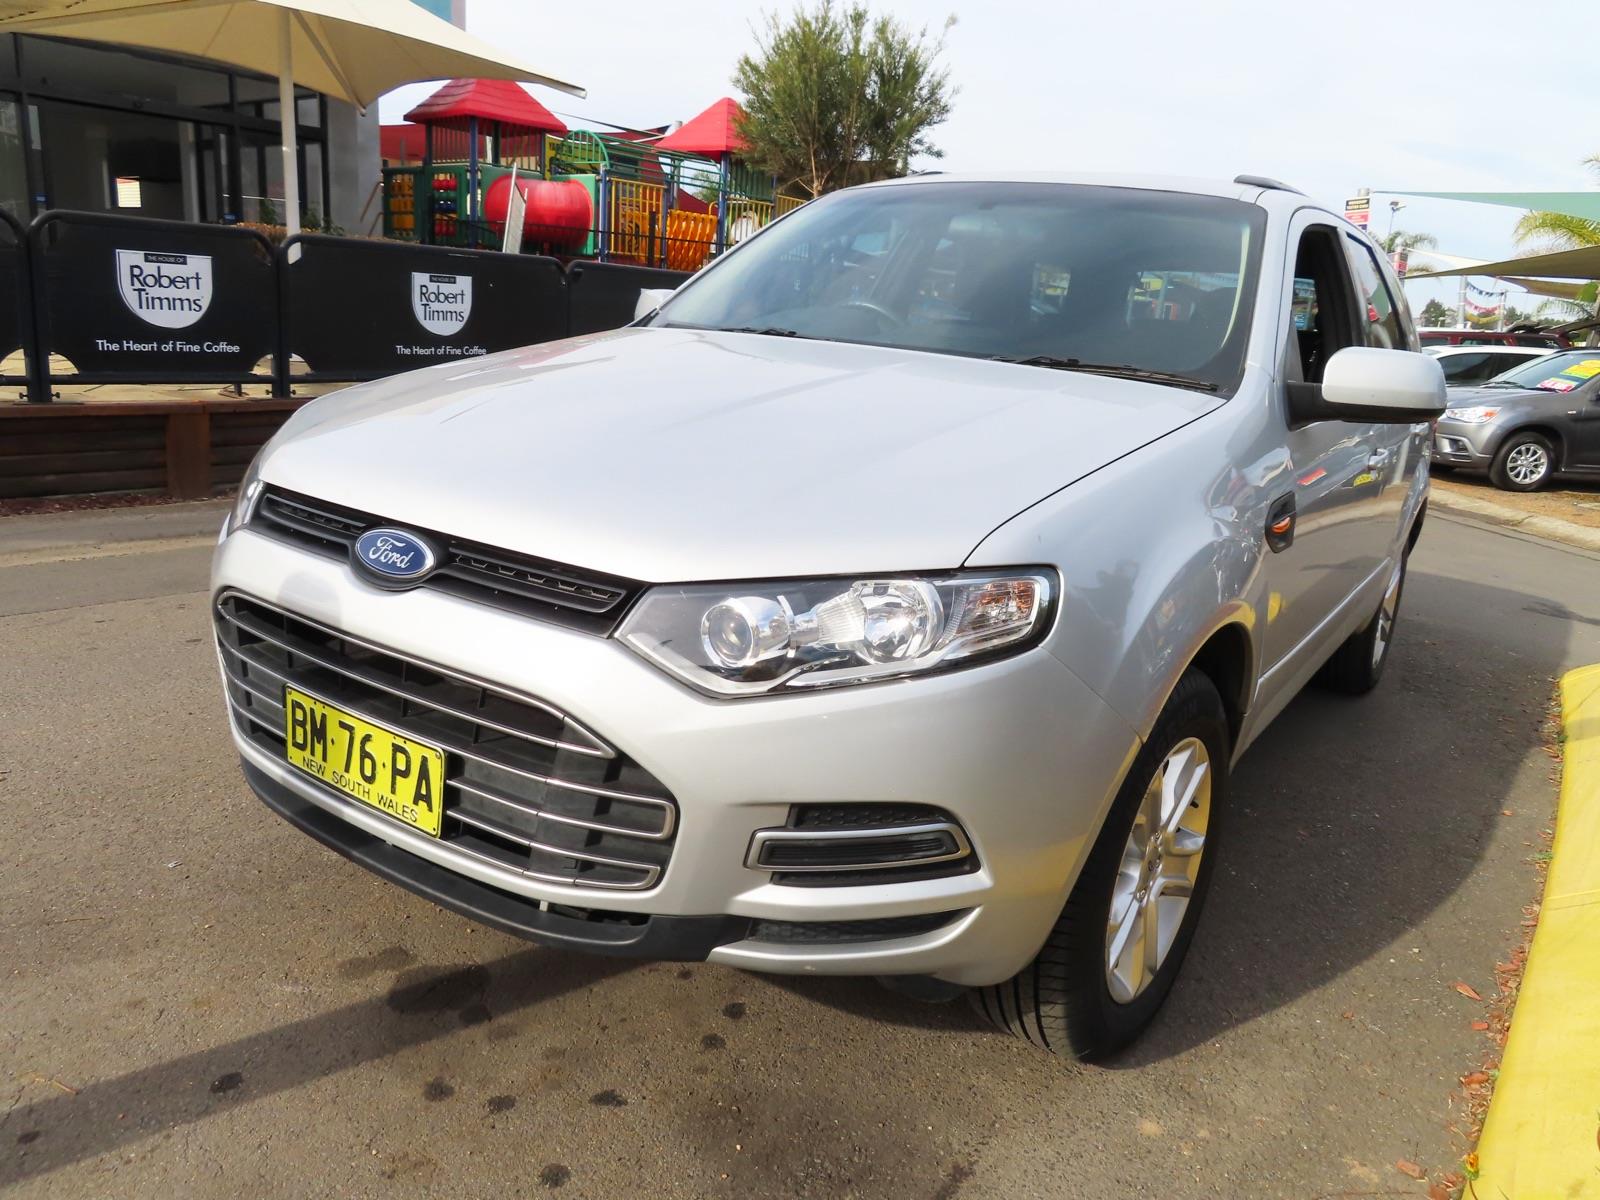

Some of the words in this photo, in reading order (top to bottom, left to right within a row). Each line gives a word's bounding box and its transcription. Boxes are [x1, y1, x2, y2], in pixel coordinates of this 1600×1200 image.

[129, 264, 202, 290] Robert
[133, 288, 203, 312] Timms
[420, 285, 465, 304] Robert
[421, 304, 465, 322] Timms
[96, 340, 120, 351] The
[123, 340, 158, 351] Heart
[161, 341, 174, 352] of
[176, 341, 201, 352] Fine
[203, 341, 240, 353] Coffee
[395, 345, 411, 355] The
[412, 345, 435, 355] Heart
[436, 345, 445, 355] of
[446, 345, 462, 355] Fine
[463, 345, 487, 356] Coffee
[368, 536, 415, 569] Ford
[302, 755, 326, 777] NEW
[332, 770, 371, 800] SOUTH
[377, 792, 418, 823] WALES
